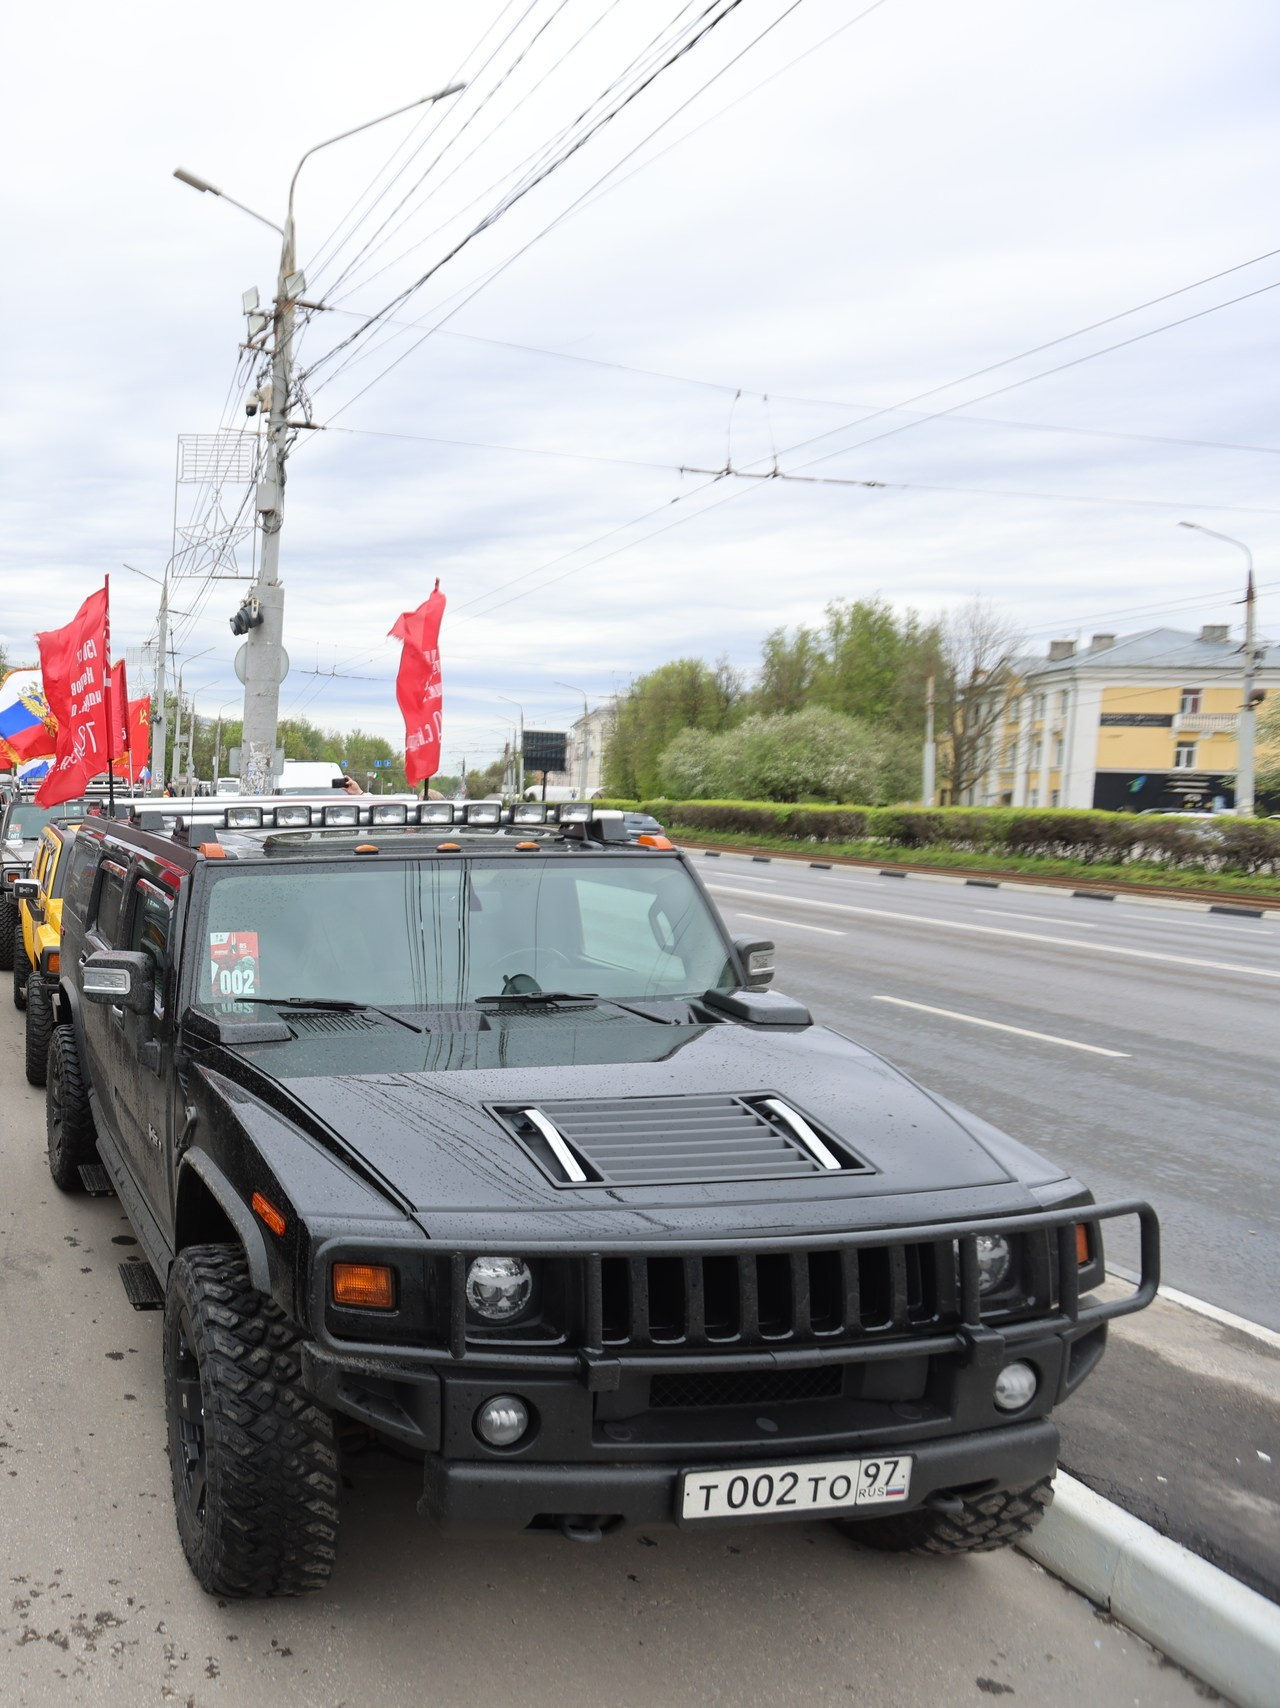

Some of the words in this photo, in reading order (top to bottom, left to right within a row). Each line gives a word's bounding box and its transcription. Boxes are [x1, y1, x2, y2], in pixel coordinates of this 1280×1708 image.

[220, 969, 255, 995] 002
[864, 1459, 900, 1488] 97
[858, 1486, 885, 1499] RUS
